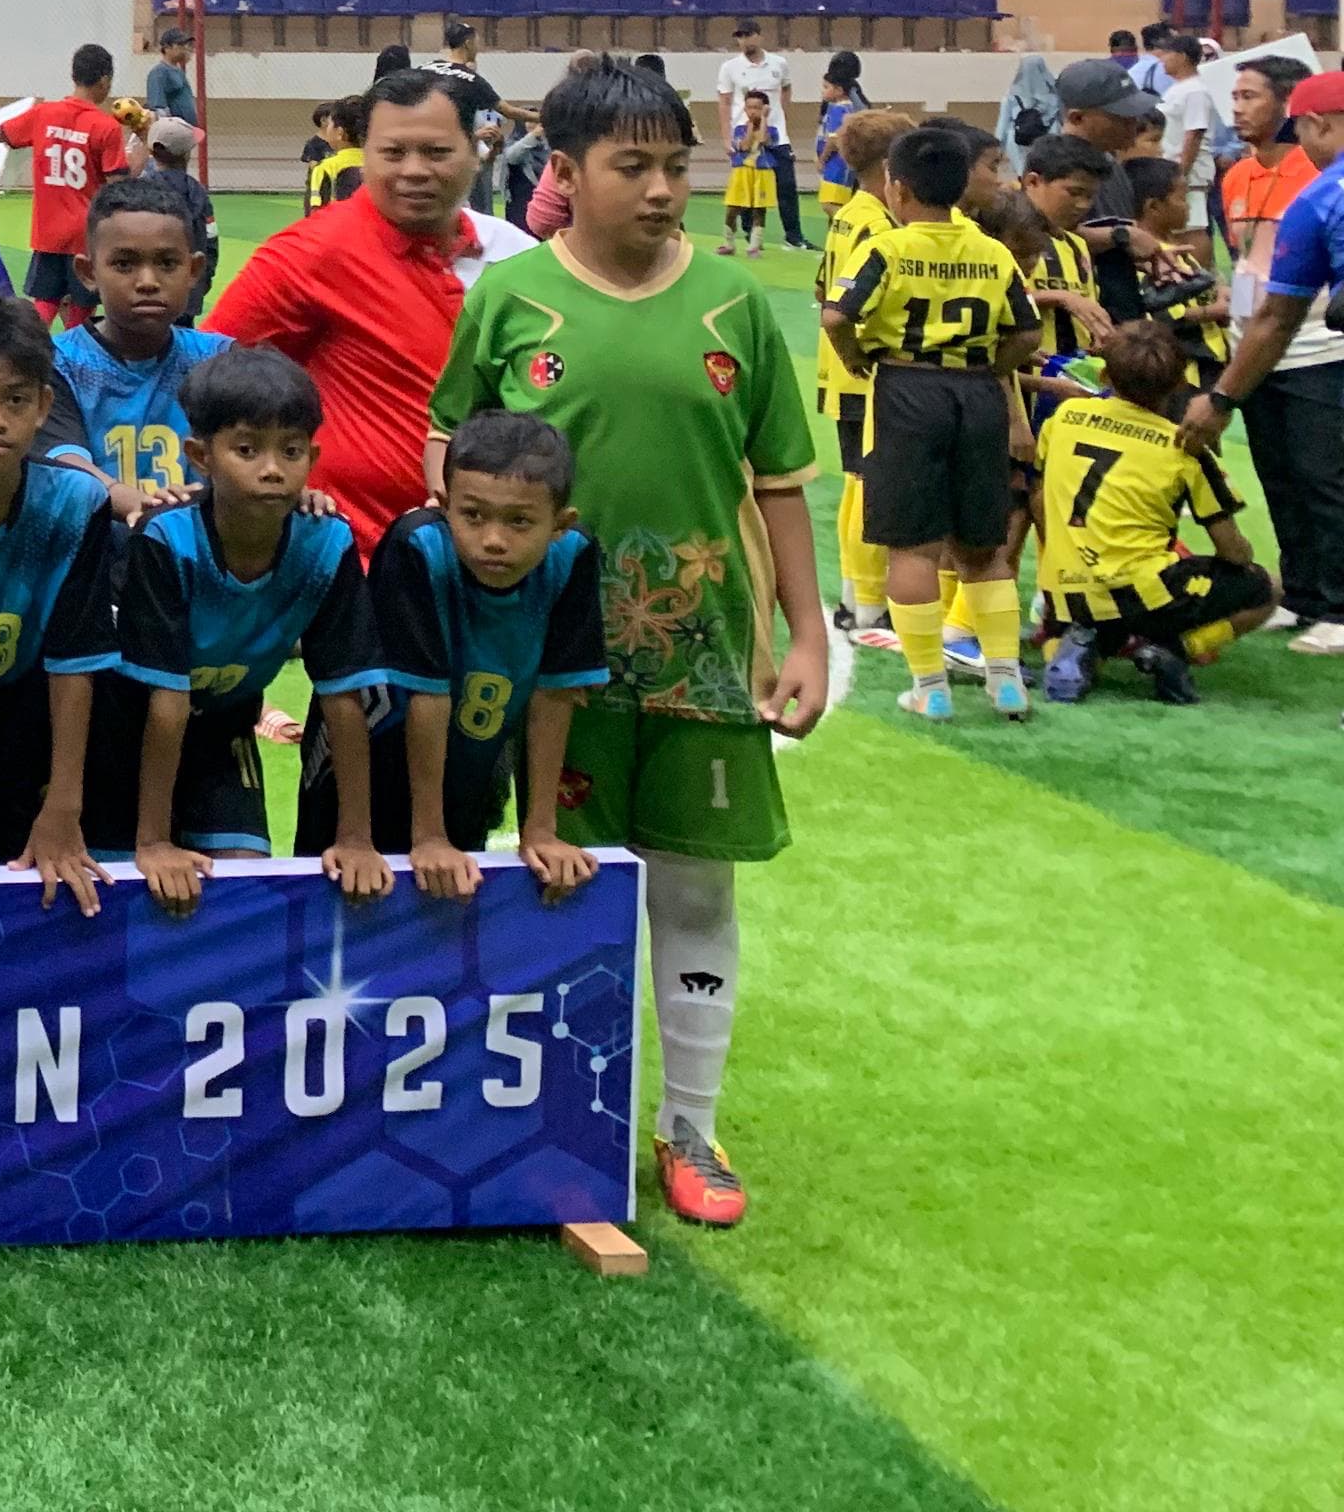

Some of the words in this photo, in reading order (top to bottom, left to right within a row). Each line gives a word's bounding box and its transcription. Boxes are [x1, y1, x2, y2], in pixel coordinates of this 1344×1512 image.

[44, 144, 88, 190] 18
[898, 258, 924, 277] SSB
[901, 296, 991, 352] 12
[1061, 410, 1088, 426] SSB
[103, 423, 186, 494] 13
[1067, 442, 1123, 528] 7
[455, 671, 513, 740] 8
[711, 758, 730, 808] 1
[182, 993, 544, 1121] 2025
